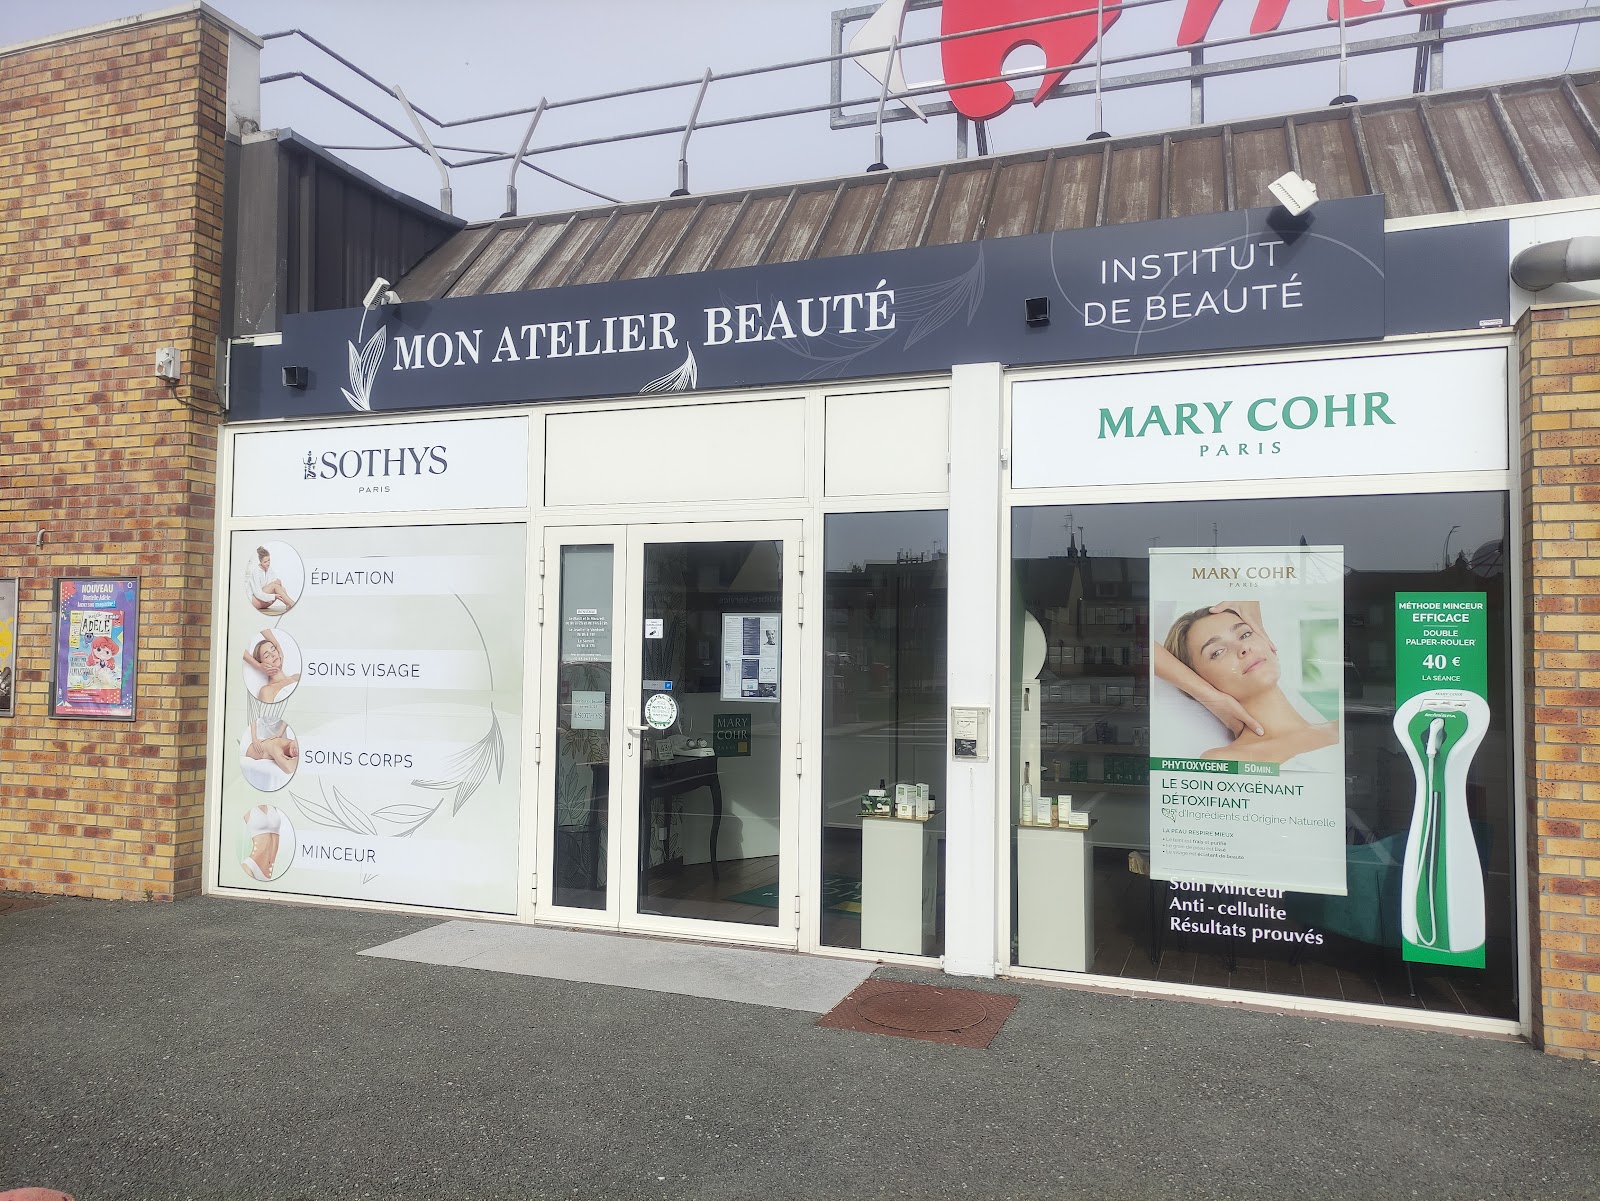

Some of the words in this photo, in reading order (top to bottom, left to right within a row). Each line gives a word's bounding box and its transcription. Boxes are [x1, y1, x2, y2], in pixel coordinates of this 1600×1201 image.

[1101, 240, 1285, 284] INSTITUT
[1084, 298, 1131, 327] DE
[1146, 272, 1304, 322] BEAUTÉ
[393, 328, 482, 371] MON
[491, 311, 678, 363] ATELIER
[703, 278, 896, 346] BEAUTÉ
[1097, 400, 1234, 440] MARY
[1246, 390, 1396, 432] COHR
[1199, 441, 1282, 457] PARIS
[319, 445, 448, 479] SOTHYS
[358, 485, 391, 494] PARIS
[310, 567, 395, 585] ÉPILATION
[1191, 567, 1242, 580] MARY
[1245, 566, 1297, 579] COHR
[81, 584, 114, 593] NOUVEAU
[1398, 601, 1441, 610] MÉTHODE
[1443, 602, 1484, 610] MINCEUR
[1412, 613, 1470, 623] EFFICACE
[1422, 654, 1447, 669] 40
[1451, 656, 1461, 667] €
[307, 662, 356, 677] SOINS
[361, 663, 421, 678] VISAGE
[1433, 674, 1461, 682] SÉANCE
[717, 717, 748, 728] MARY
[717, 730, 748, 740] COHR
[304, 750, 353, 766] SOINS
[357, 752, 414, 768] CORPS
[1161, 760, 1229, 772] PHYTOXYGENE
[1244, 763, 1274, 774] 50MIN.
[1162, 778, 1178, 789] LE
[1181, 779, 1213, 791] SOIN
[1216, 780, 1304, 796] OXYGÉNANT
[1162, 792, 1251, 809] DÉTOXIFIANT
[1178, 809, 1241, 822] d'Ingrédients
[1242, 812, 1287, 826] d'Origine
[1289, 816, 1336, 828] Naturelle
[1188, 829, 1213, 837] RESPIRE
[301, 844, 377, 864] MINCEUR
[1169, 876, 1206, 892] Soin
[1170, 916, 1247, 937] Résultats
[1252, 928, 1324, 945] prouvés
